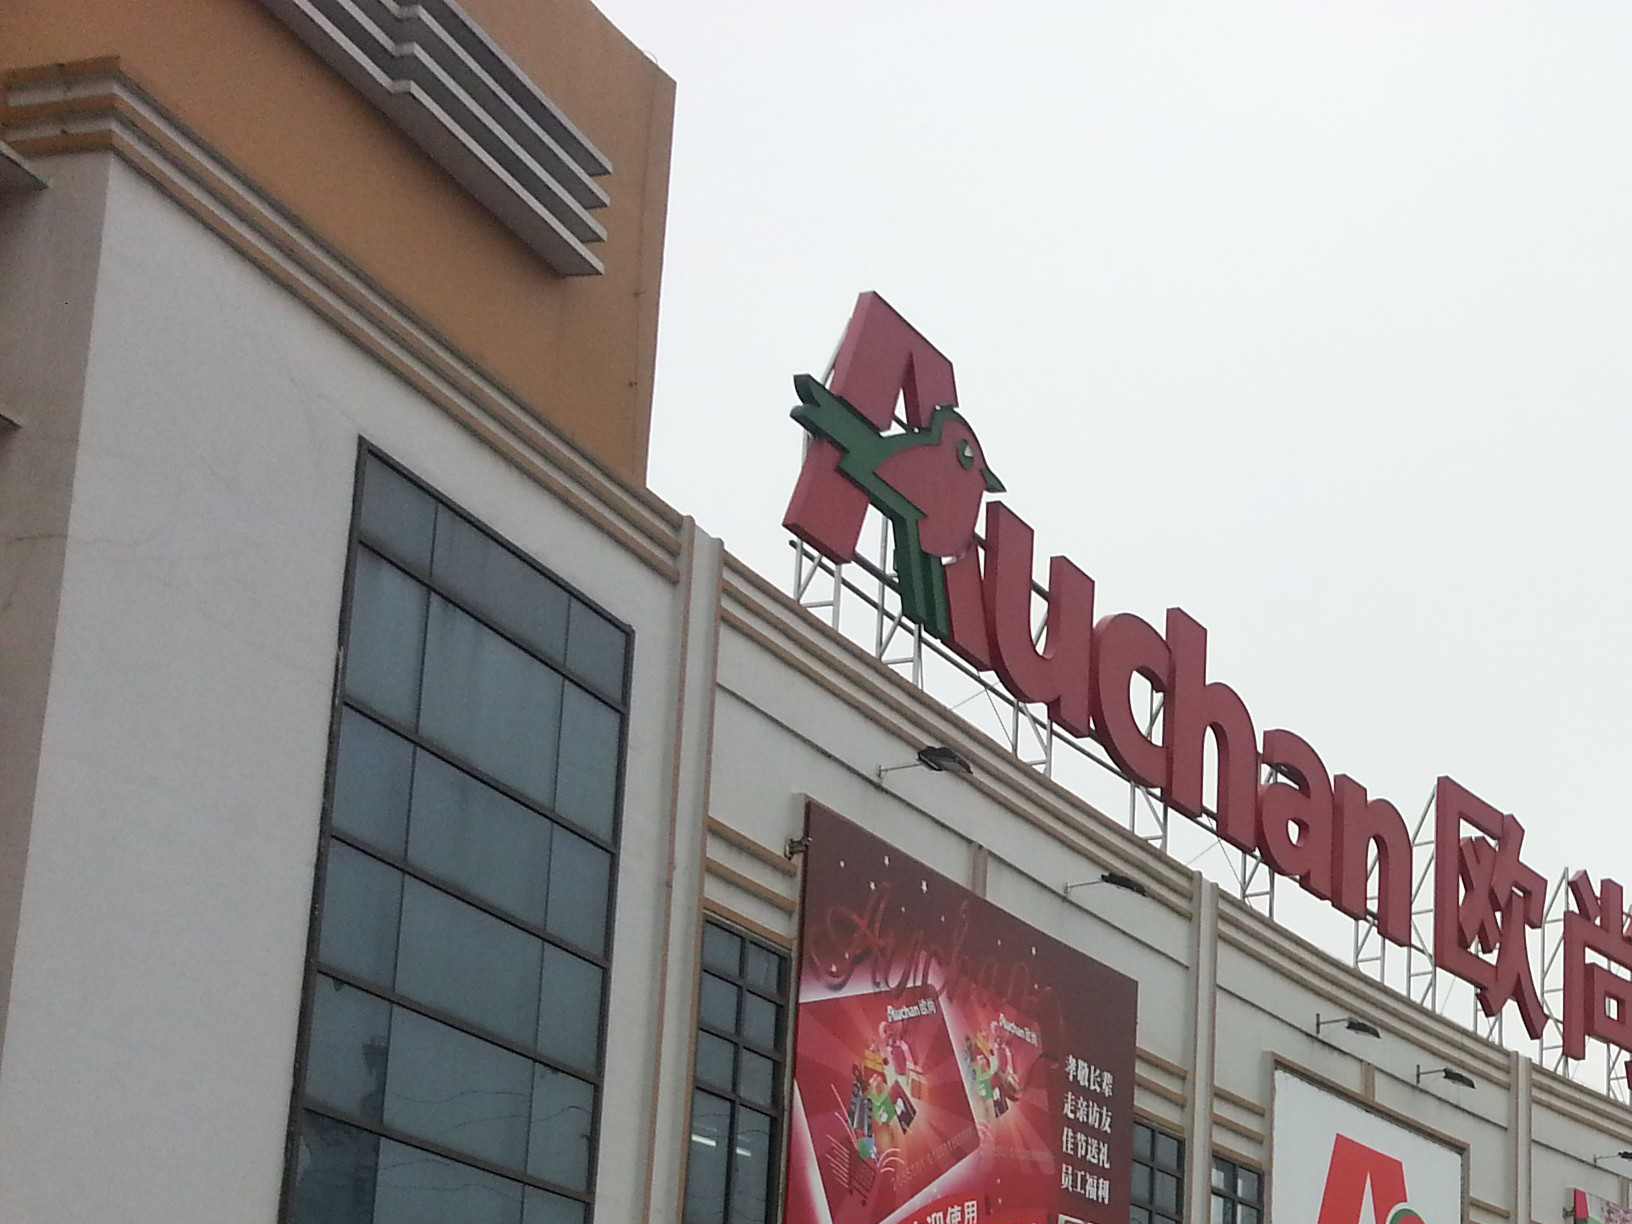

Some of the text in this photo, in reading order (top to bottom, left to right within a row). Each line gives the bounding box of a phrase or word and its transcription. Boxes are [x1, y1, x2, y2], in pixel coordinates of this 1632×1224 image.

[783, 290, 1412, 947] Auchan
[1065, 1054, 1114, 1098] 孝敬长辈
[1063, 1091, 1113, 1134] 走亲访友
[1062, 1126, 1111, 1169] 佳节送礼
[1061, 1163, 1111, 1205] 员工福利
